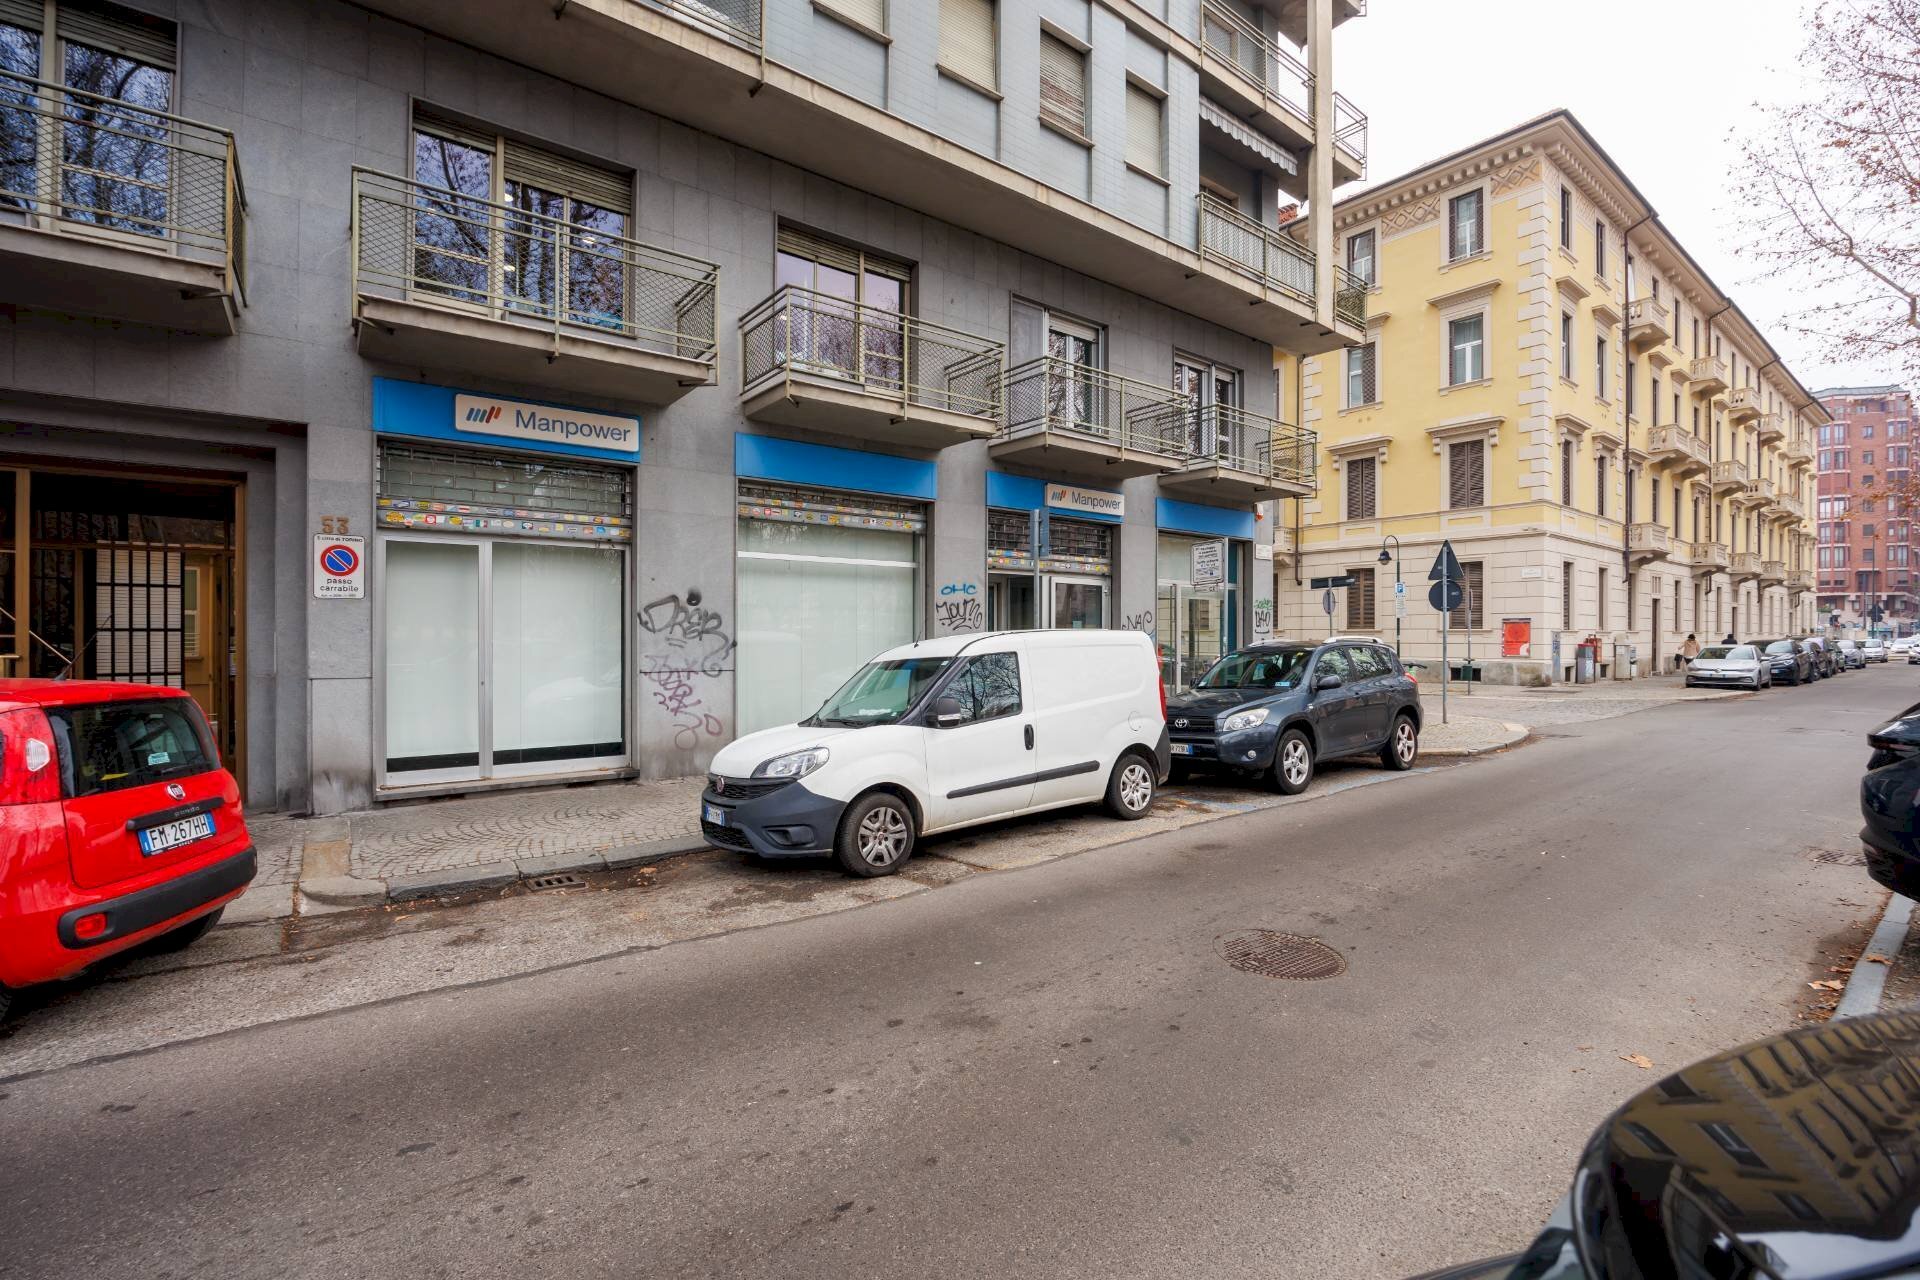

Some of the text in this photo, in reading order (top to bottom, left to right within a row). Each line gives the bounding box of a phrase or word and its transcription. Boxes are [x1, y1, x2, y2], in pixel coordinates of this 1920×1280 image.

[515, 409, 632, 442] Manpower
[1071, 490, 1122, 510] Manpower
[321, 516, 349, 534] 53
[320, 584, 359, 592] carrabile
[941, 584, 977, 595] OHC
[149, 815, 208, 848] FM 267HH
